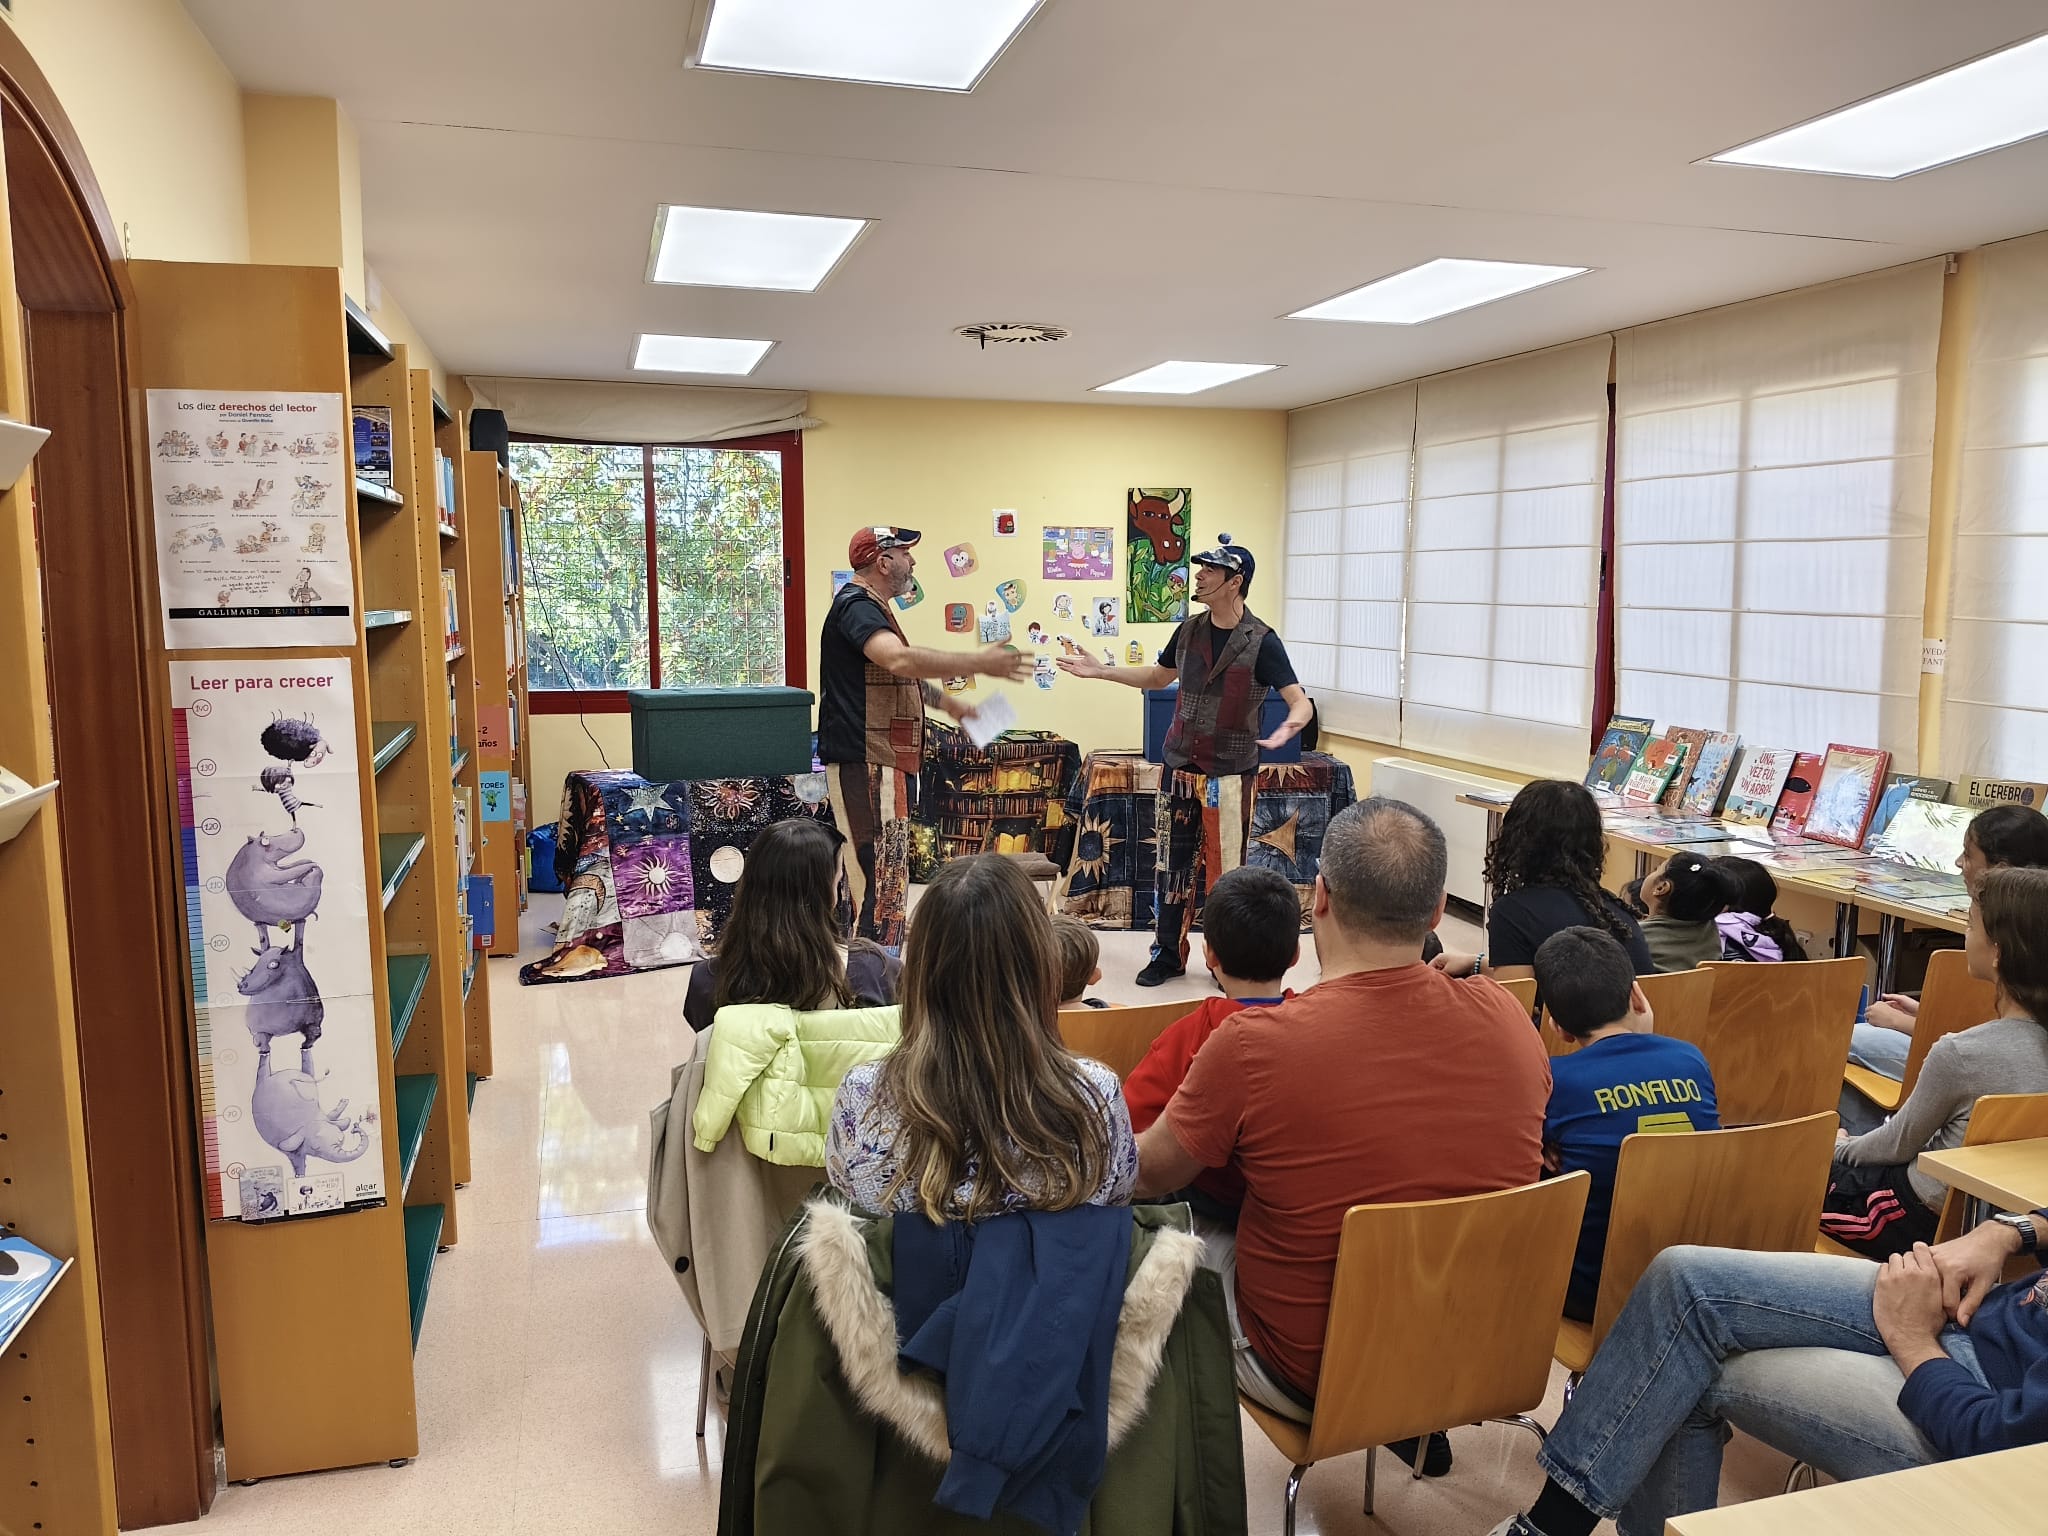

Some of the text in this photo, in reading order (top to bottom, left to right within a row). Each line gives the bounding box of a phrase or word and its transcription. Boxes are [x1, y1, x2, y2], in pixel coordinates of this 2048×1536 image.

[177, 401, 317, 413] Los diez derechos del lector
[198, 608, 260, 617] GALLIMARD
[190, 675, 334, 693] Leer para crecer
[1969, 781, 1981, 797] EL
[1594, 1078, 1702, 1114] RONALDO
[355, 1183, 377, 1193] algar
